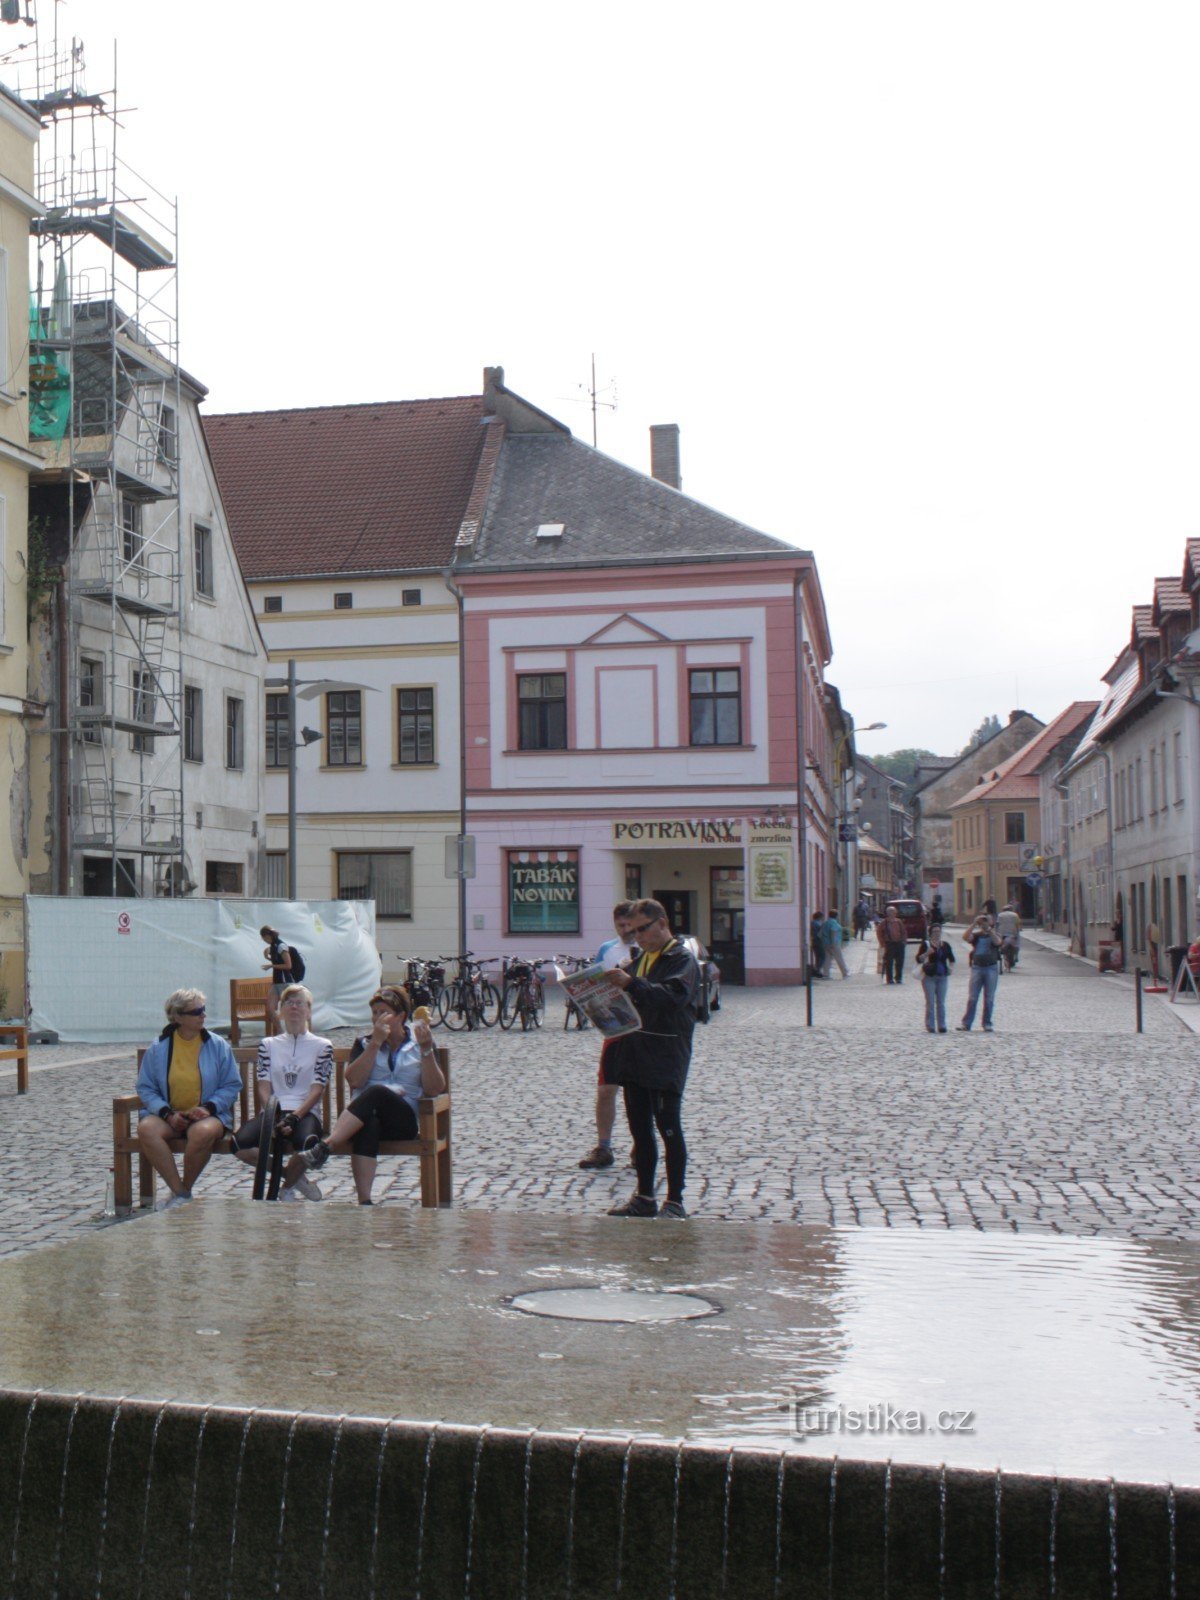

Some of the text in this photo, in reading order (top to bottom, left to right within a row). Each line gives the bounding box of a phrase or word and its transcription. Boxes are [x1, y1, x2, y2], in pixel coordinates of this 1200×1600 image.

[614, 821, 735, 840] POTRAVINY
[750, 834, 792, 843] zmrzlina
[513, 865, 576, 883] TABÁK
[513, 888, 576, 902] NOVINY
